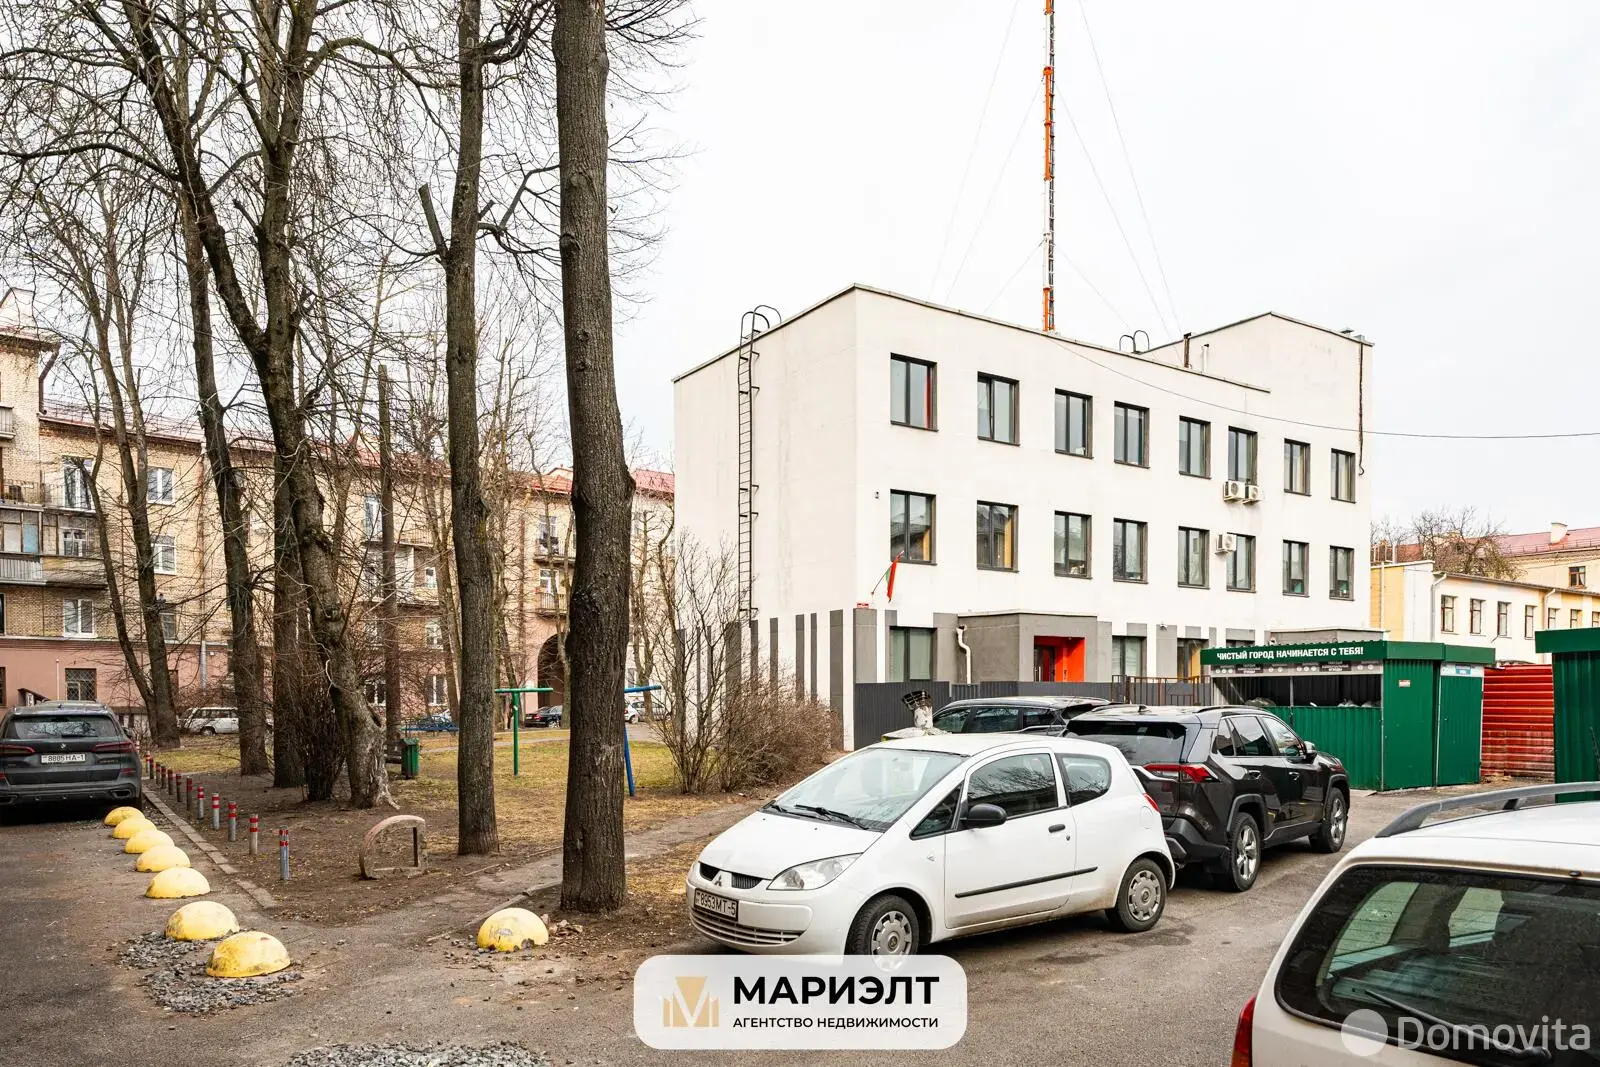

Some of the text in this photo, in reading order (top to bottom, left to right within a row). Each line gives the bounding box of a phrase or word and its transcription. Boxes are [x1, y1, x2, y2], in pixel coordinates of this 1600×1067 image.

[1216, 646, 1364, 661] ЧИСТЫЙ ГОРОД НАЧИНАЕТСЯ С ТЕБЯ!
